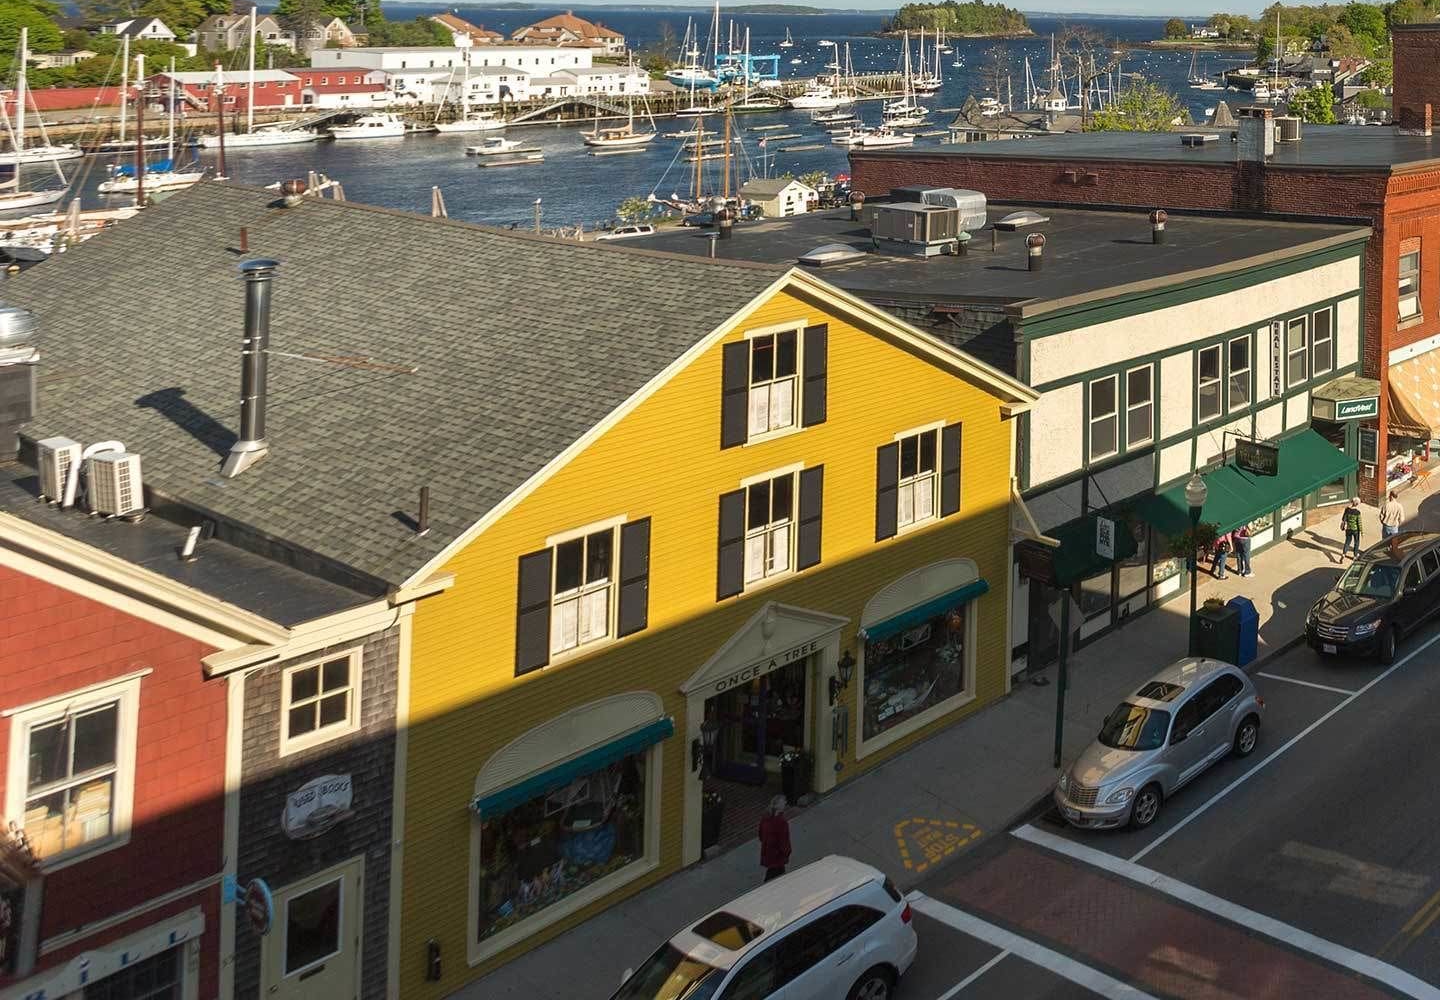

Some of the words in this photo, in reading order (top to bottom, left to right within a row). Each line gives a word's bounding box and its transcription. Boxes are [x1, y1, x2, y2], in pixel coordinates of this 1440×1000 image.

[715, 665, 760, 692] ONCE
[767, 657, 777, 670] A
[784, 641, 818, 662] TREE
